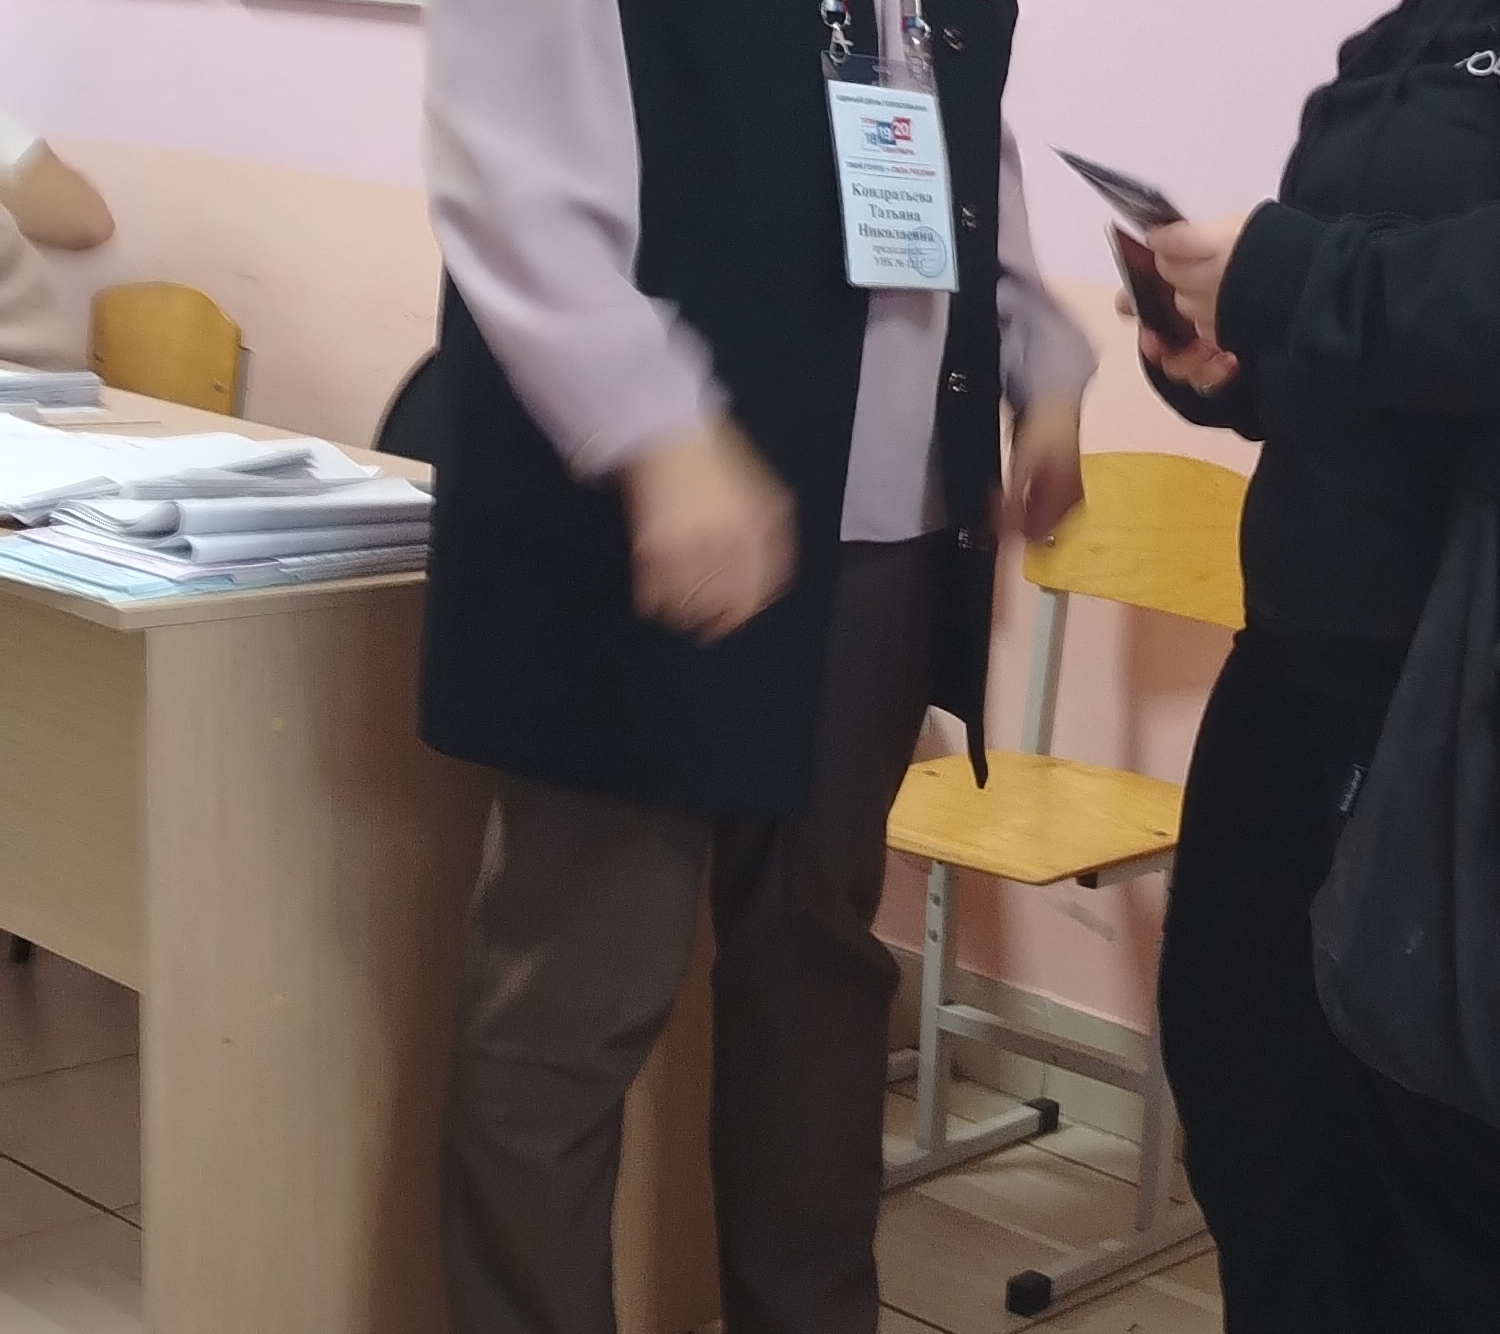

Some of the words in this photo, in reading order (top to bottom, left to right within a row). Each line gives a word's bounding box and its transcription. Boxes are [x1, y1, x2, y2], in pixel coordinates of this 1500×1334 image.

[879, 126, 893, 141] 19
[893, 121, 909, 137] 20
[852, 182, 932, 204] Кондратьева
[868, 203, 921, 222] Татьяна
